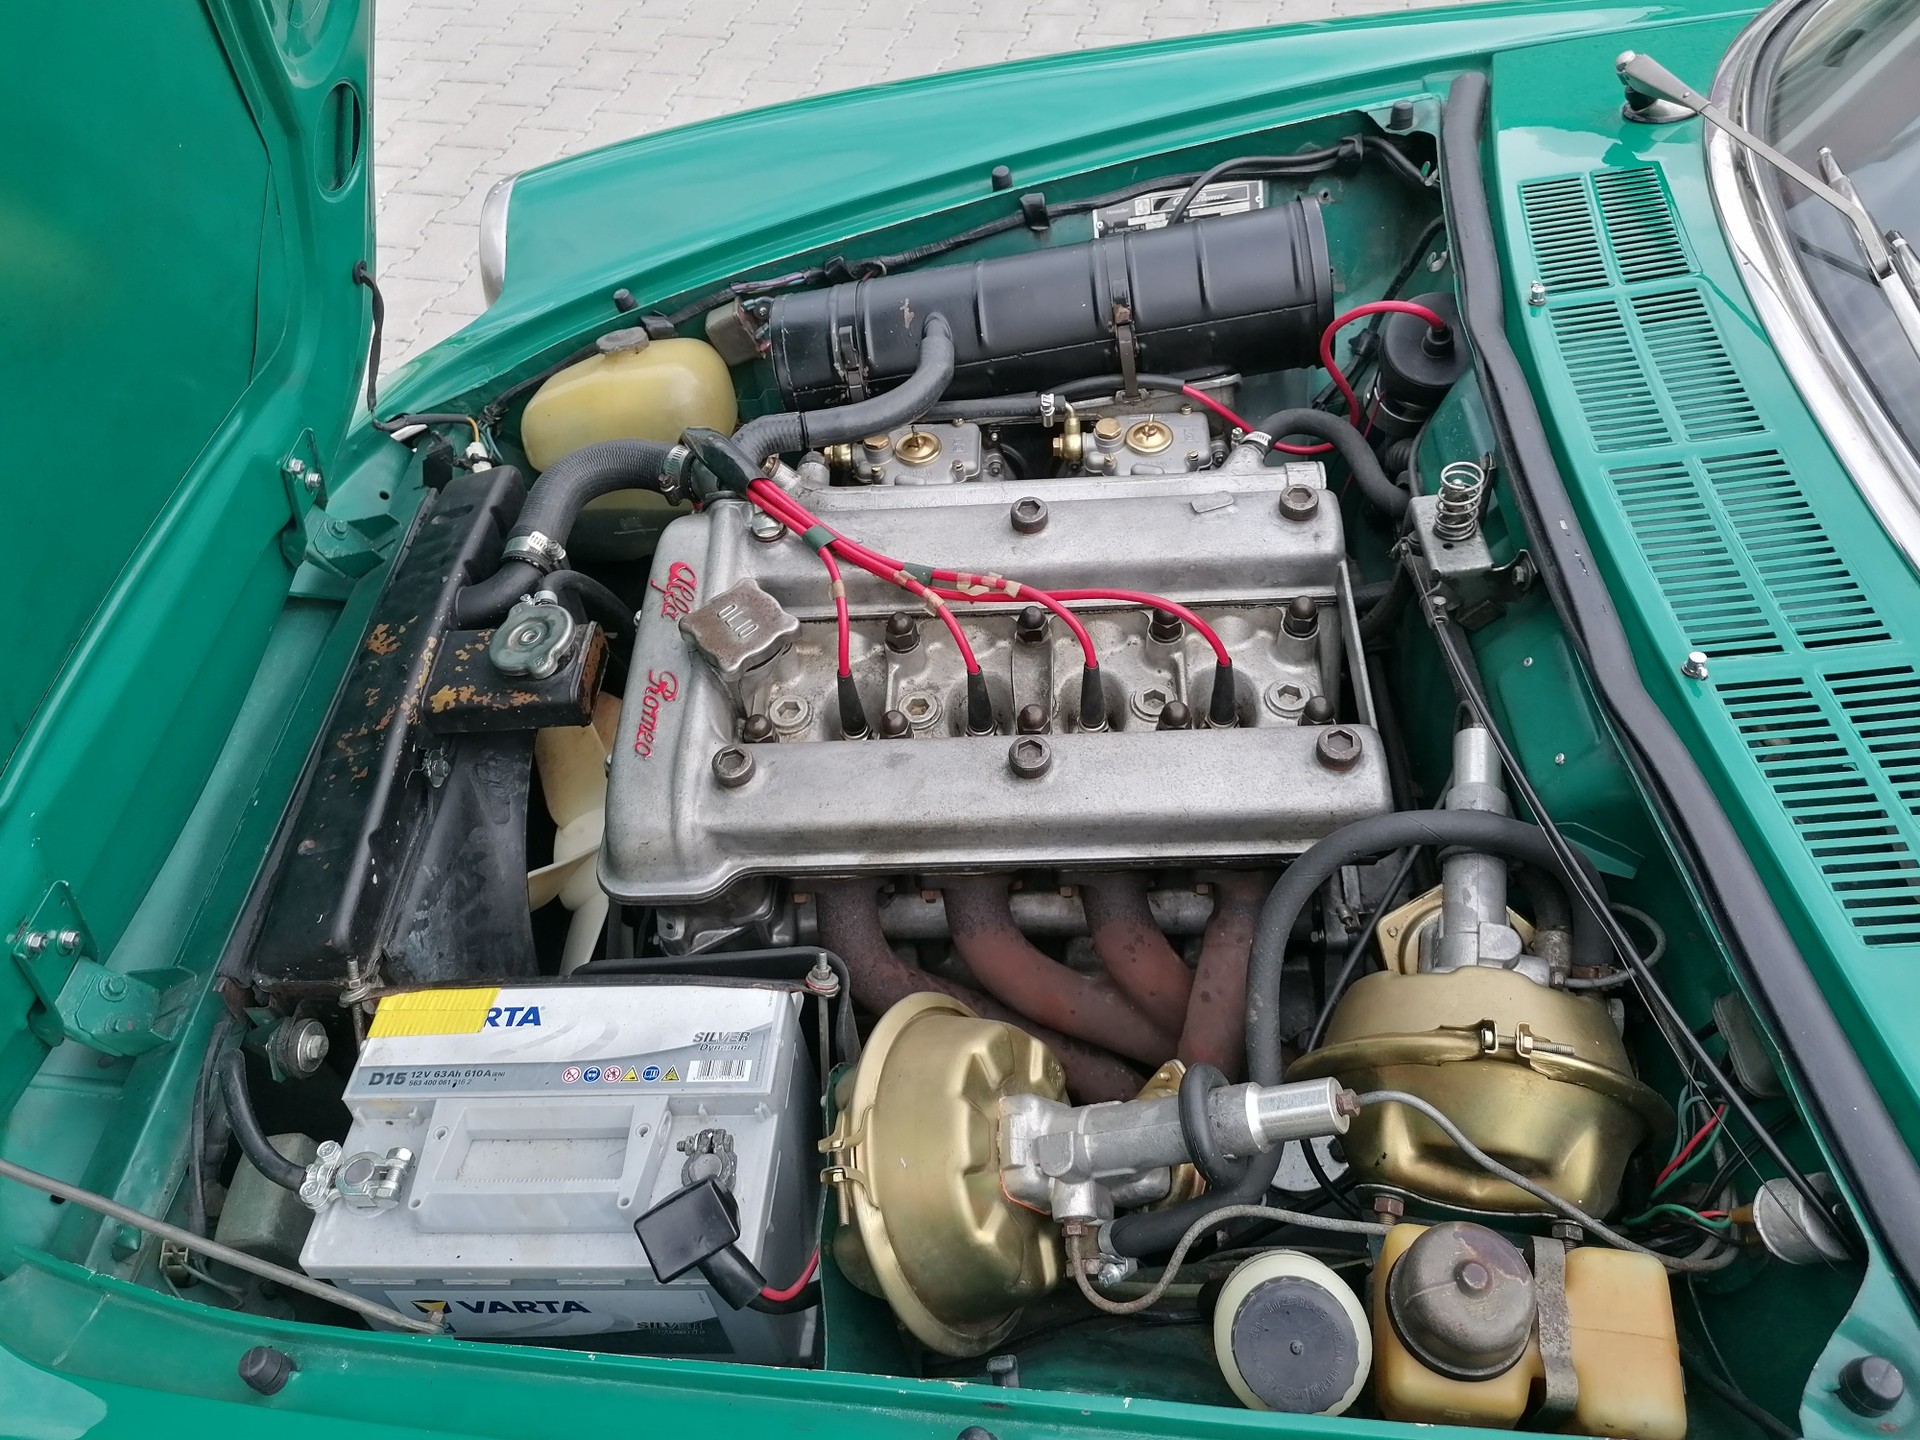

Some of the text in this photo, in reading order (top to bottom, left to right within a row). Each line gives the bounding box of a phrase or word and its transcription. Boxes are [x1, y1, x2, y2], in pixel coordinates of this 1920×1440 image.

[717, 603, 760, 639] OLIO
[634, 561, 696, 759] Alfa Romeo
[484, 1006, 542, 1028] RTA
[693, 1031, 751, 1043] SILVER
[699, 1043, 748, 1053] Dynamic
[368, 1071, 408, 1086] D15
[434, 1070, 461, 1078] 63Ah
[455, 1300, 592, 1314] VARTA
[637, 1321, 704, 1330] SILVER
